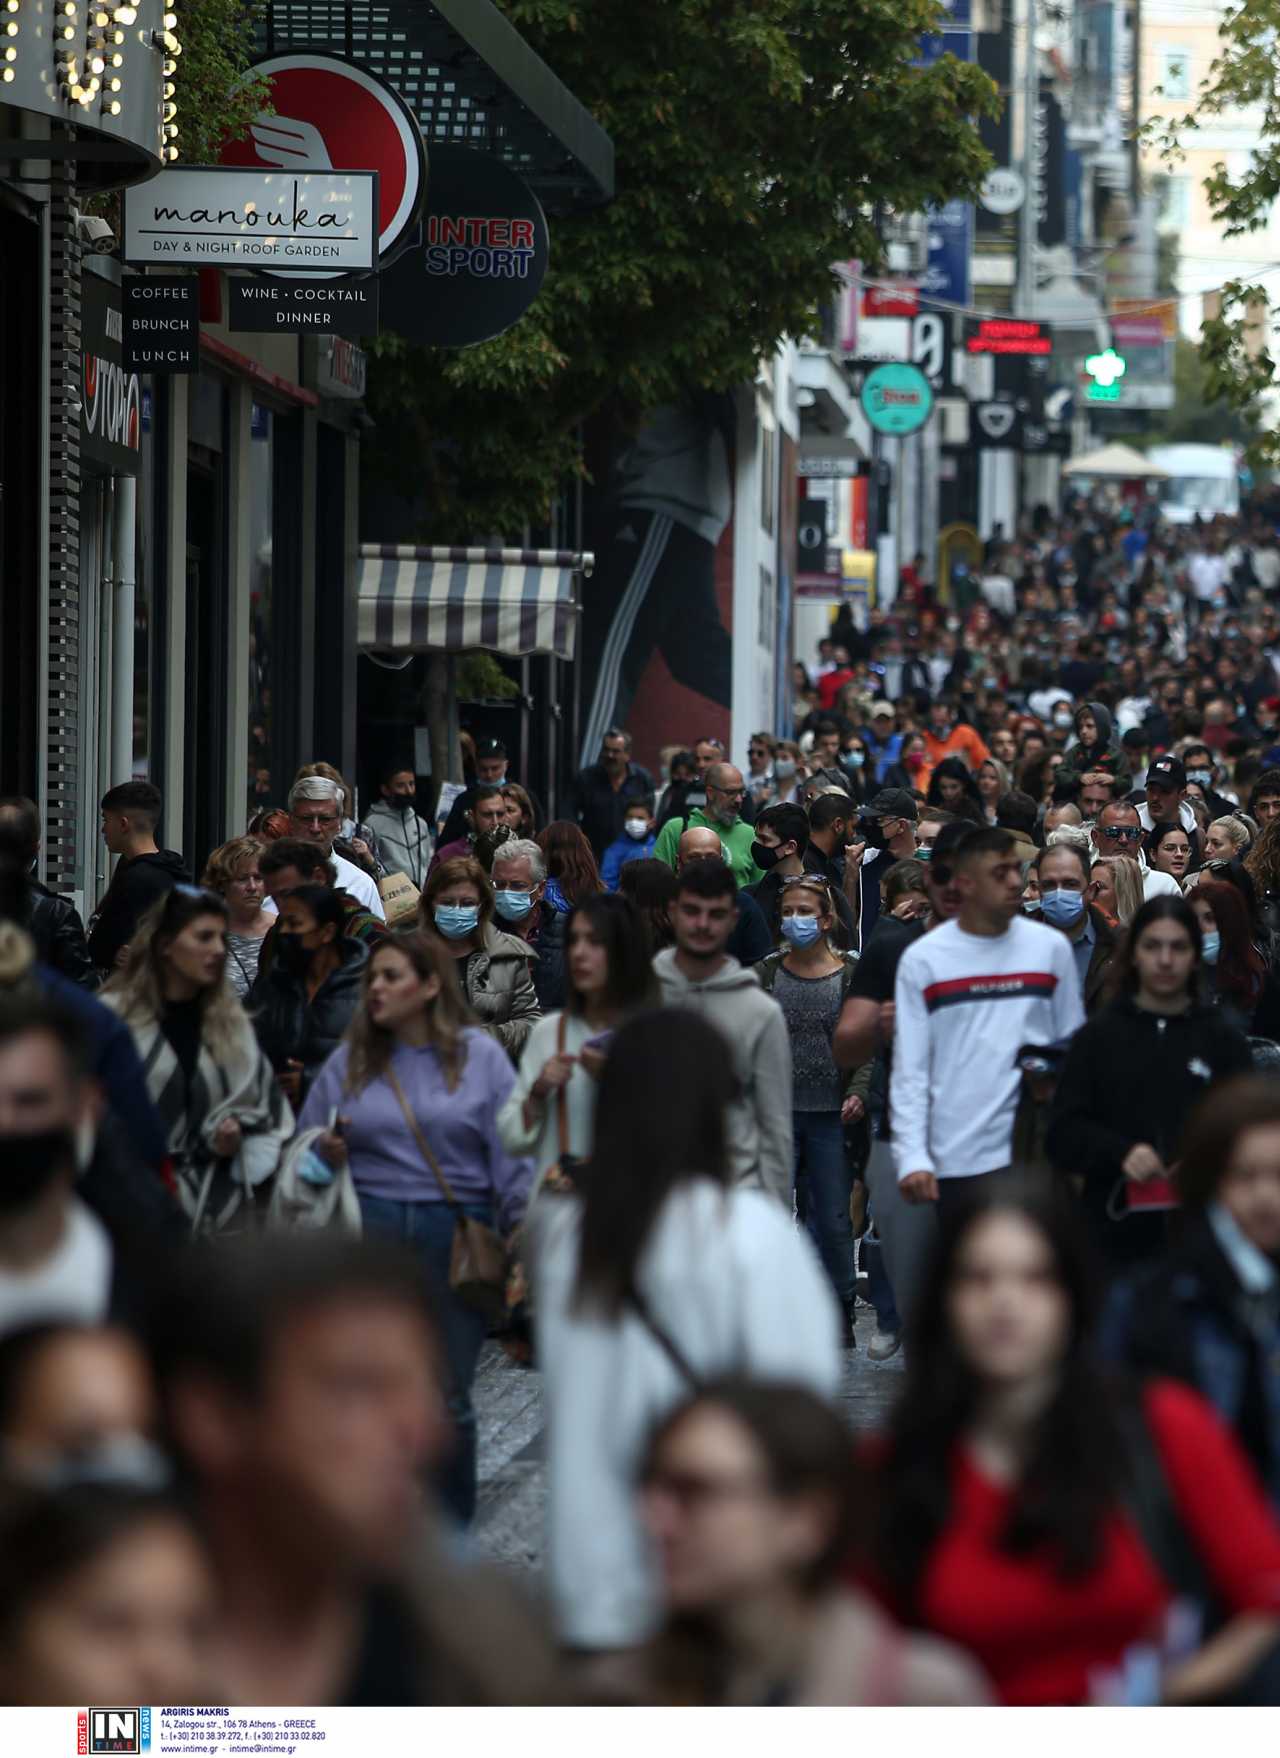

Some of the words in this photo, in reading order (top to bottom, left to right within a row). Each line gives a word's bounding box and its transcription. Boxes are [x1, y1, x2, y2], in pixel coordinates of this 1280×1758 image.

[154, 180, 349, 232] manouka
[428, 216, 535, 248] INTER
[153, 240, 178, 252] DAY
[183, 242, 192, 252] &
[196, 242, 238, 254] NIGHT
[242, 243, 281, 255] ROOF
[284, 245, 340, 257] GARDEN
[426, 245, 535, 278] SPORT
[131, 288, 189, 299] COFFEE
[241, 287, 278, 299] WINE
[294, 289, 367, 301] COCKTAIL
[132, 319, 189, 330] BRUNCH
[276, 312, 331, 324] DINNER
[132, 351, 189, 362] LUNCH
